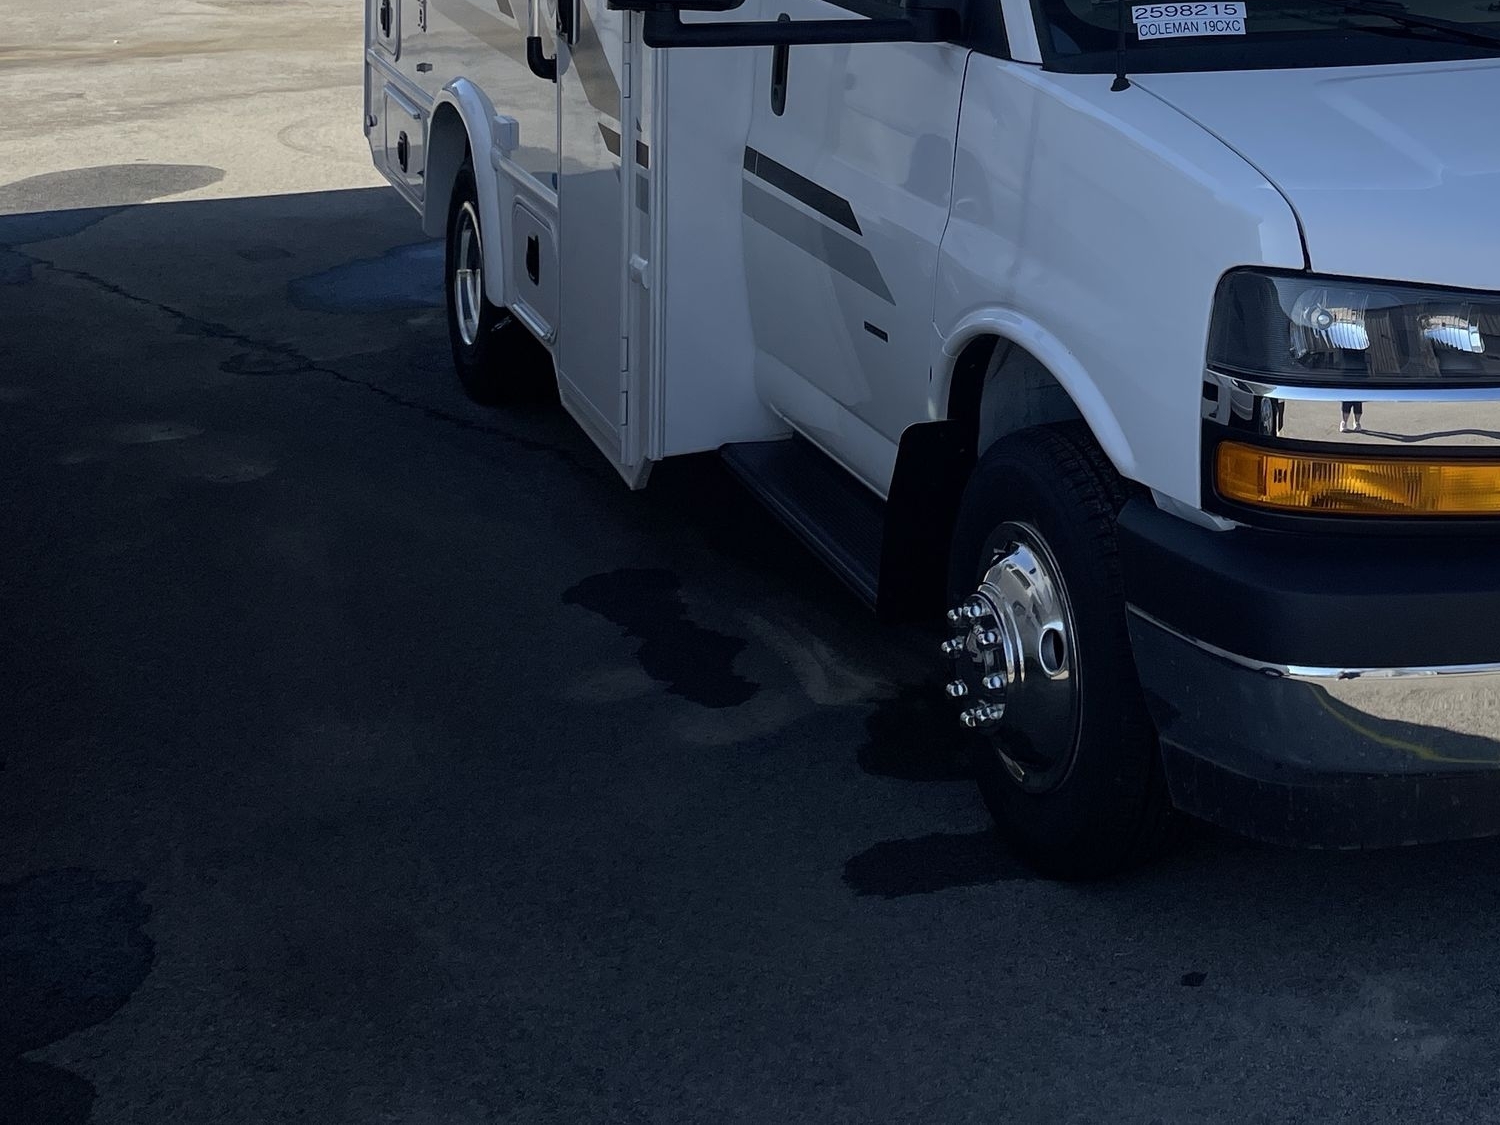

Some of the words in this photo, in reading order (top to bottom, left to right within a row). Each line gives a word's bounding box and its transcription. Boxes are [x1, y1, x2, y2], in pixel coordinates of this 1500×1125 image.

[1134, 3, 1238, 20] 2598215
[1139, 21, 1199, 37] COLEMAN
[1203, 19, 1241, 33] 19CXC
